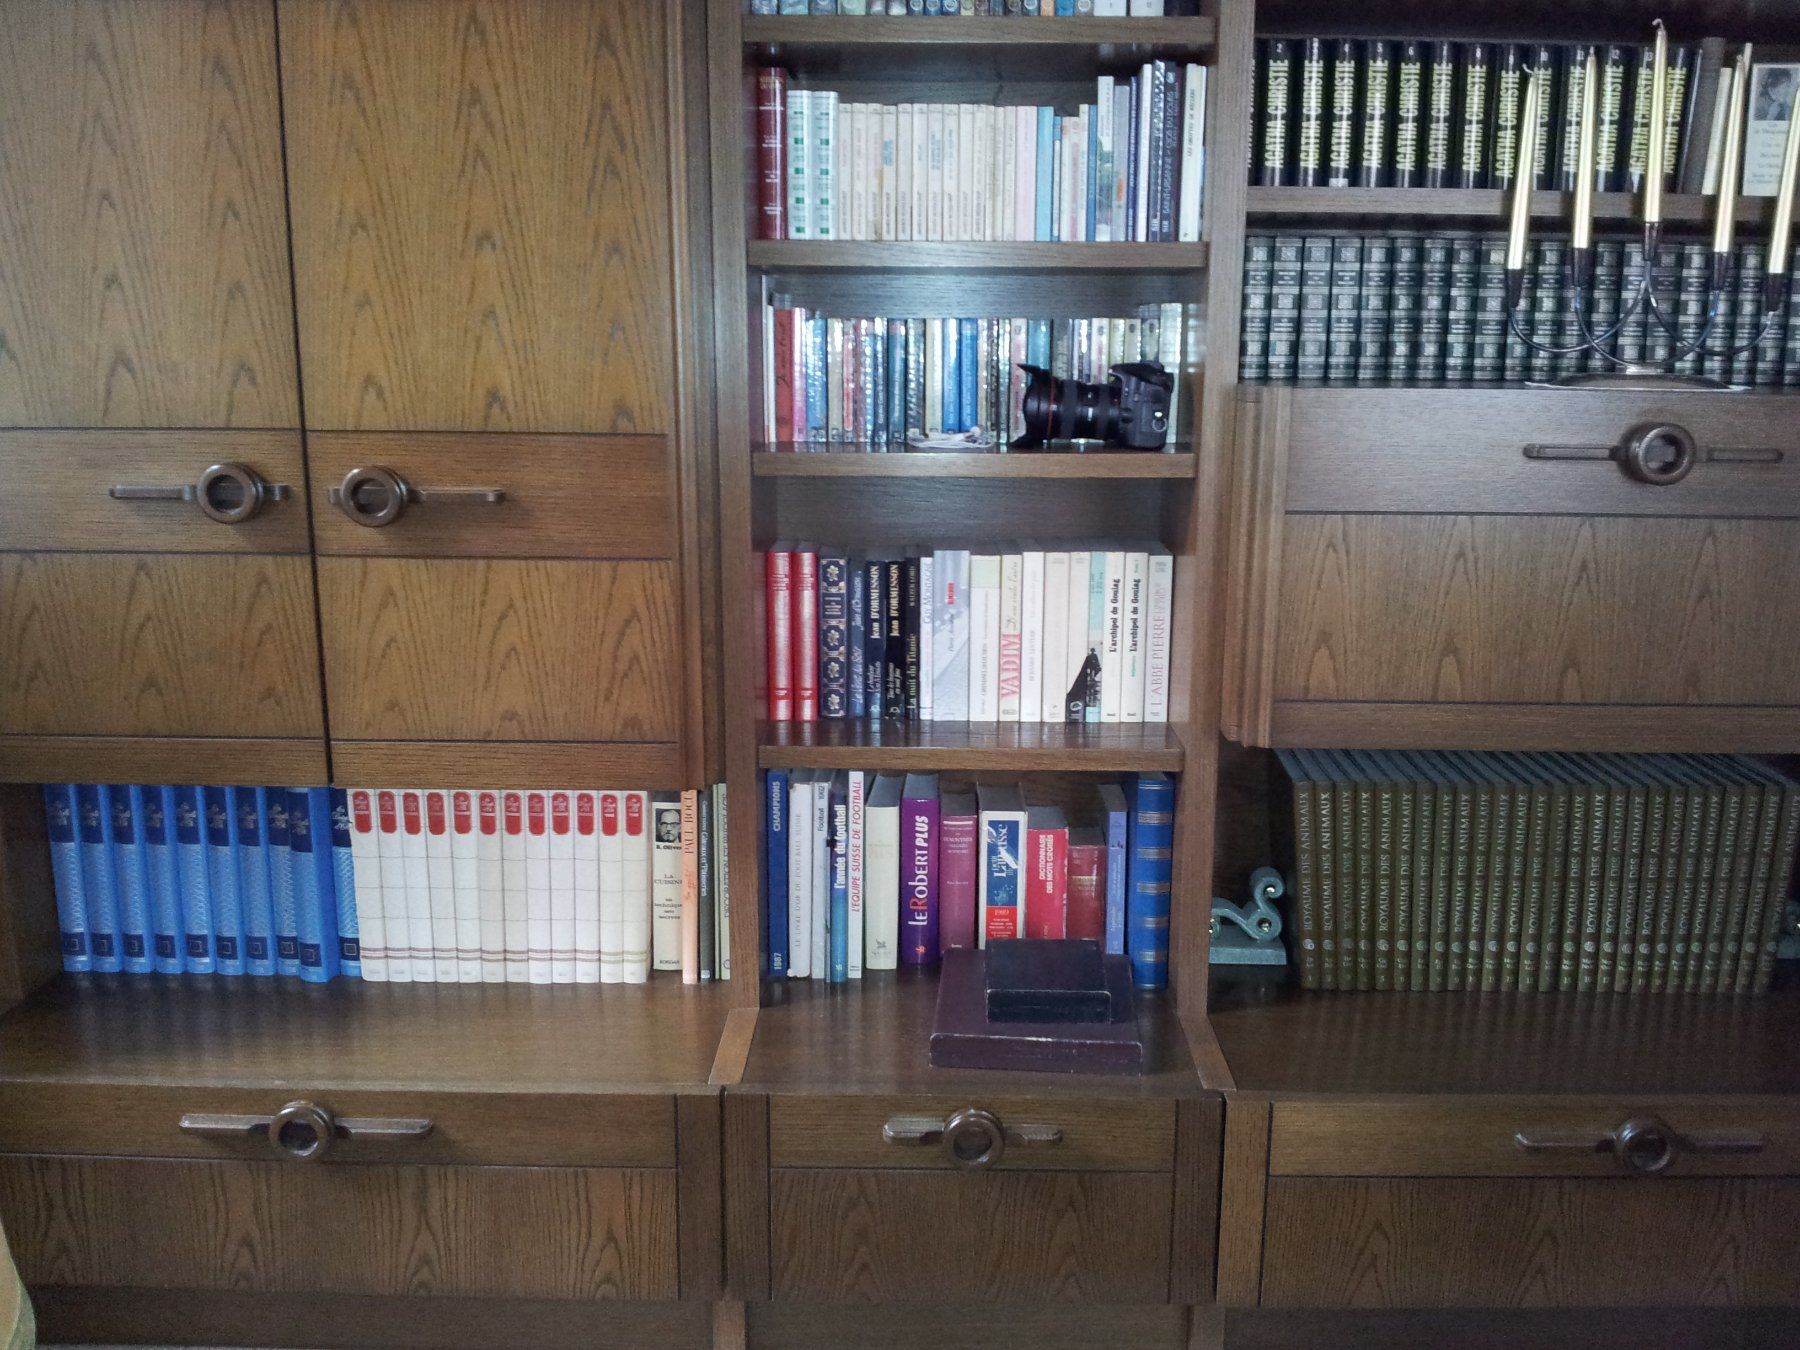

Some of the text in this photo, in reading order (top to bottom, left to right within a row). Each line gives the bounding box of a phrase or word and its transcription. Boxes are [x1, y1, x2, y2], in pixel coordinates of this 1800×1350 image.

[1264, 59, 1289, 168] AGATHA CHRISTIE
[1300, 60, 1324, 168] AGATHA CHRISTIE
[1330, 60, 1355, 168] AGATHA CHRISTIE
[1362, 60, 1388, 168] AGATHA CHRISTIE
[1396, 62, 1421, 171] AGATHA CHRISTIE
[1427, 63, 1453, 170] AGATHA CHRISTIE
[1462, 64, 1487, 172] AGATHA CHRISTIE
[1495, 70, 1520, 178] AGATHA CHRISTIE
[1596, 65, 1624, 172] AGATHA CHRISTIE
[870, 565, 881, 639] Jean D'ORMESSON
[889, 564, 900, 637] Jean D'ORMESSON
[1109, 578, 1120, 653] L'archipel du Goulag
[1131, 606, 1139, 615] du
[1132, 578, 1140, 604] Goulag
[906, 634, 916, 709] La nuit du Titanic
[1000, 634, 1022, 698] VADIM
[1129, 618, 1138, 652] L'archipel
[1152, 614, 1166, 660] PIERRE
[773, 782, 781, 832] CHAMPIONS
[852, 781, 862, 825] FOOTBALL
[852, 828, 861, 840] DE
[914, 815, 929, 847] PLUS
[684, 830, 694, 854] PAUL
[834, 804, 846, 889] l'année du football
[852, 844, 861, 872] SUISSE
[1046, 862, 1054, 881] MOTS
